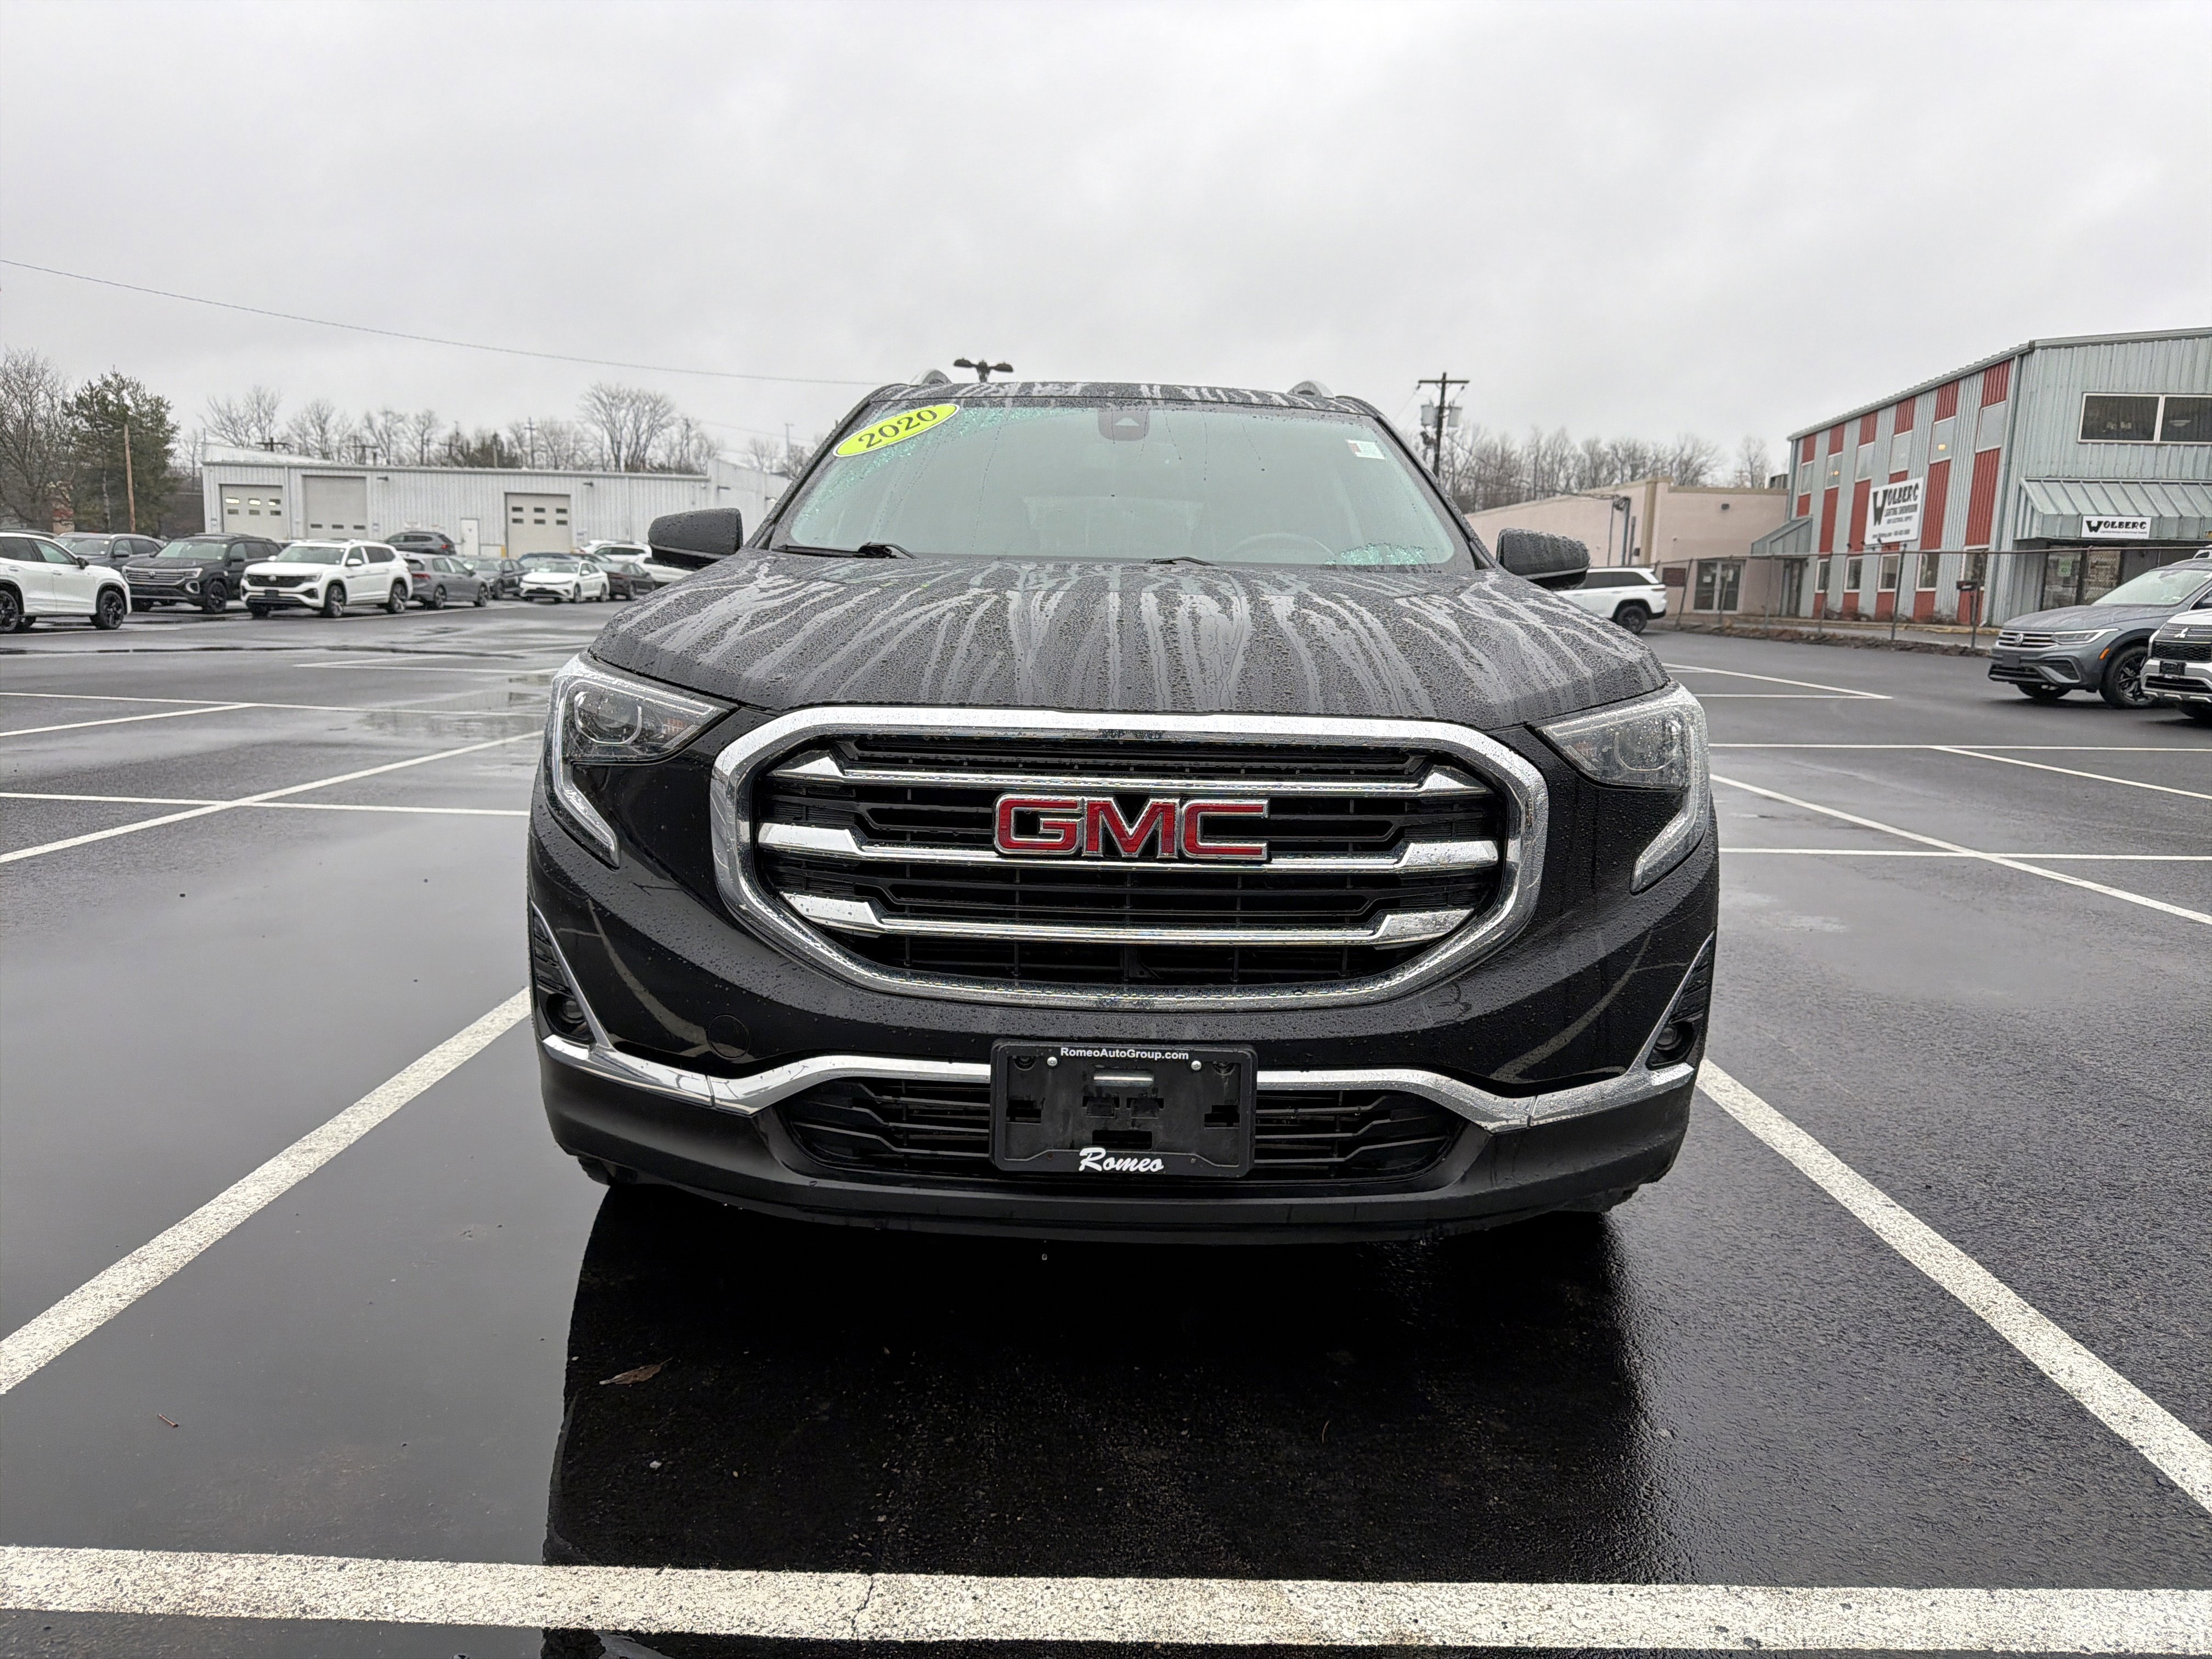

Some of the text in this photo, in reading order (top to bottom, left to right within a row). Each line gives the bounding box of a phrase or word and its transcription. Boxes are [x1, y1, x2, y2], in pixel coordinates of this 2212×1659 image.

[858, 410, 937, 449] 2020
[994, 794, 1269, 861] GMC
[1060, 1047, 1189, 1060] RomeoAutoGroup.com
[1079, 1147, 1164, 1172] Romeo
